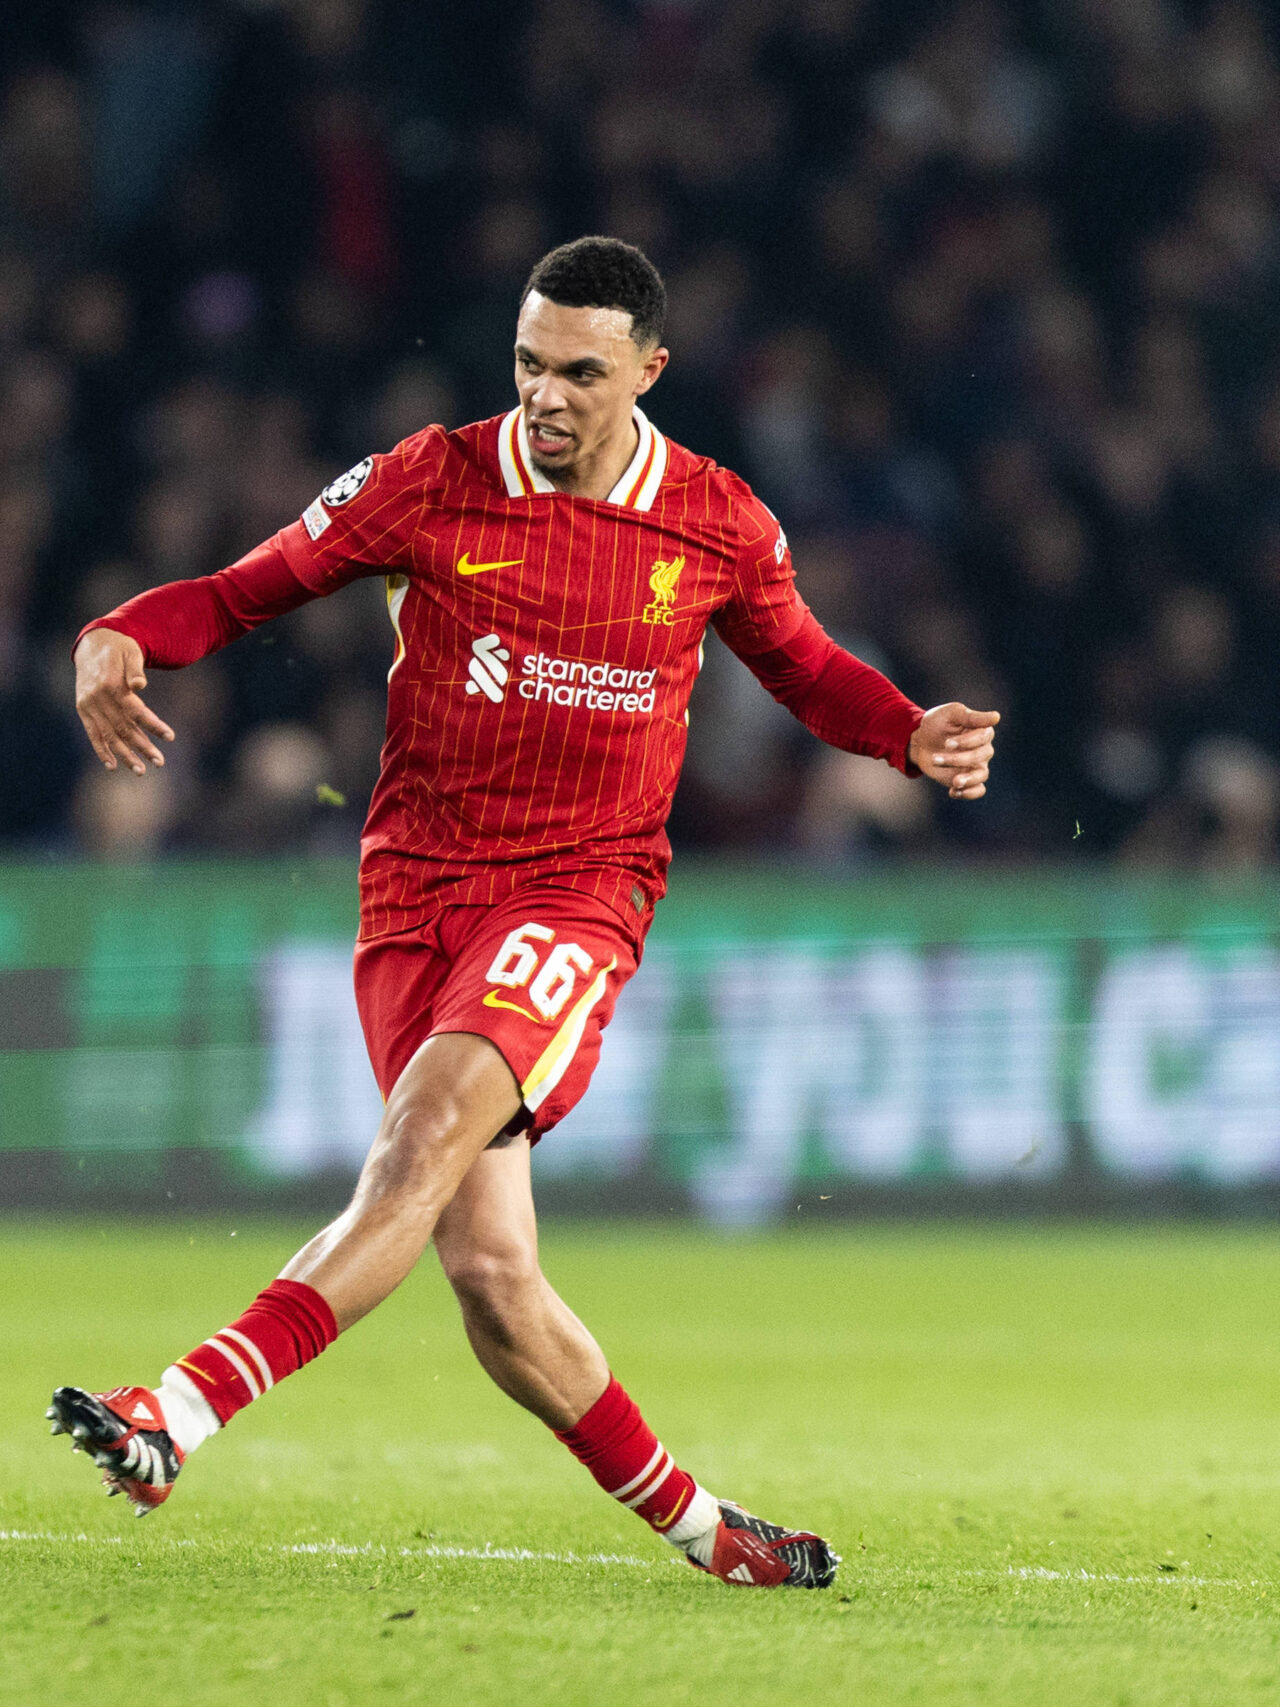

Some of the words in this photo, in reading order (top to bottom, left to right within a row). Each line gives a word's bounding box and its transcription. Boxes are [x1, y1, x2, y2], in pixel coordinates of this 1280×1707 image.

[521, 652, 657, 690] standard
[518, 677, 656, 713] chartered
[485, 922, 594, 1021] 66
